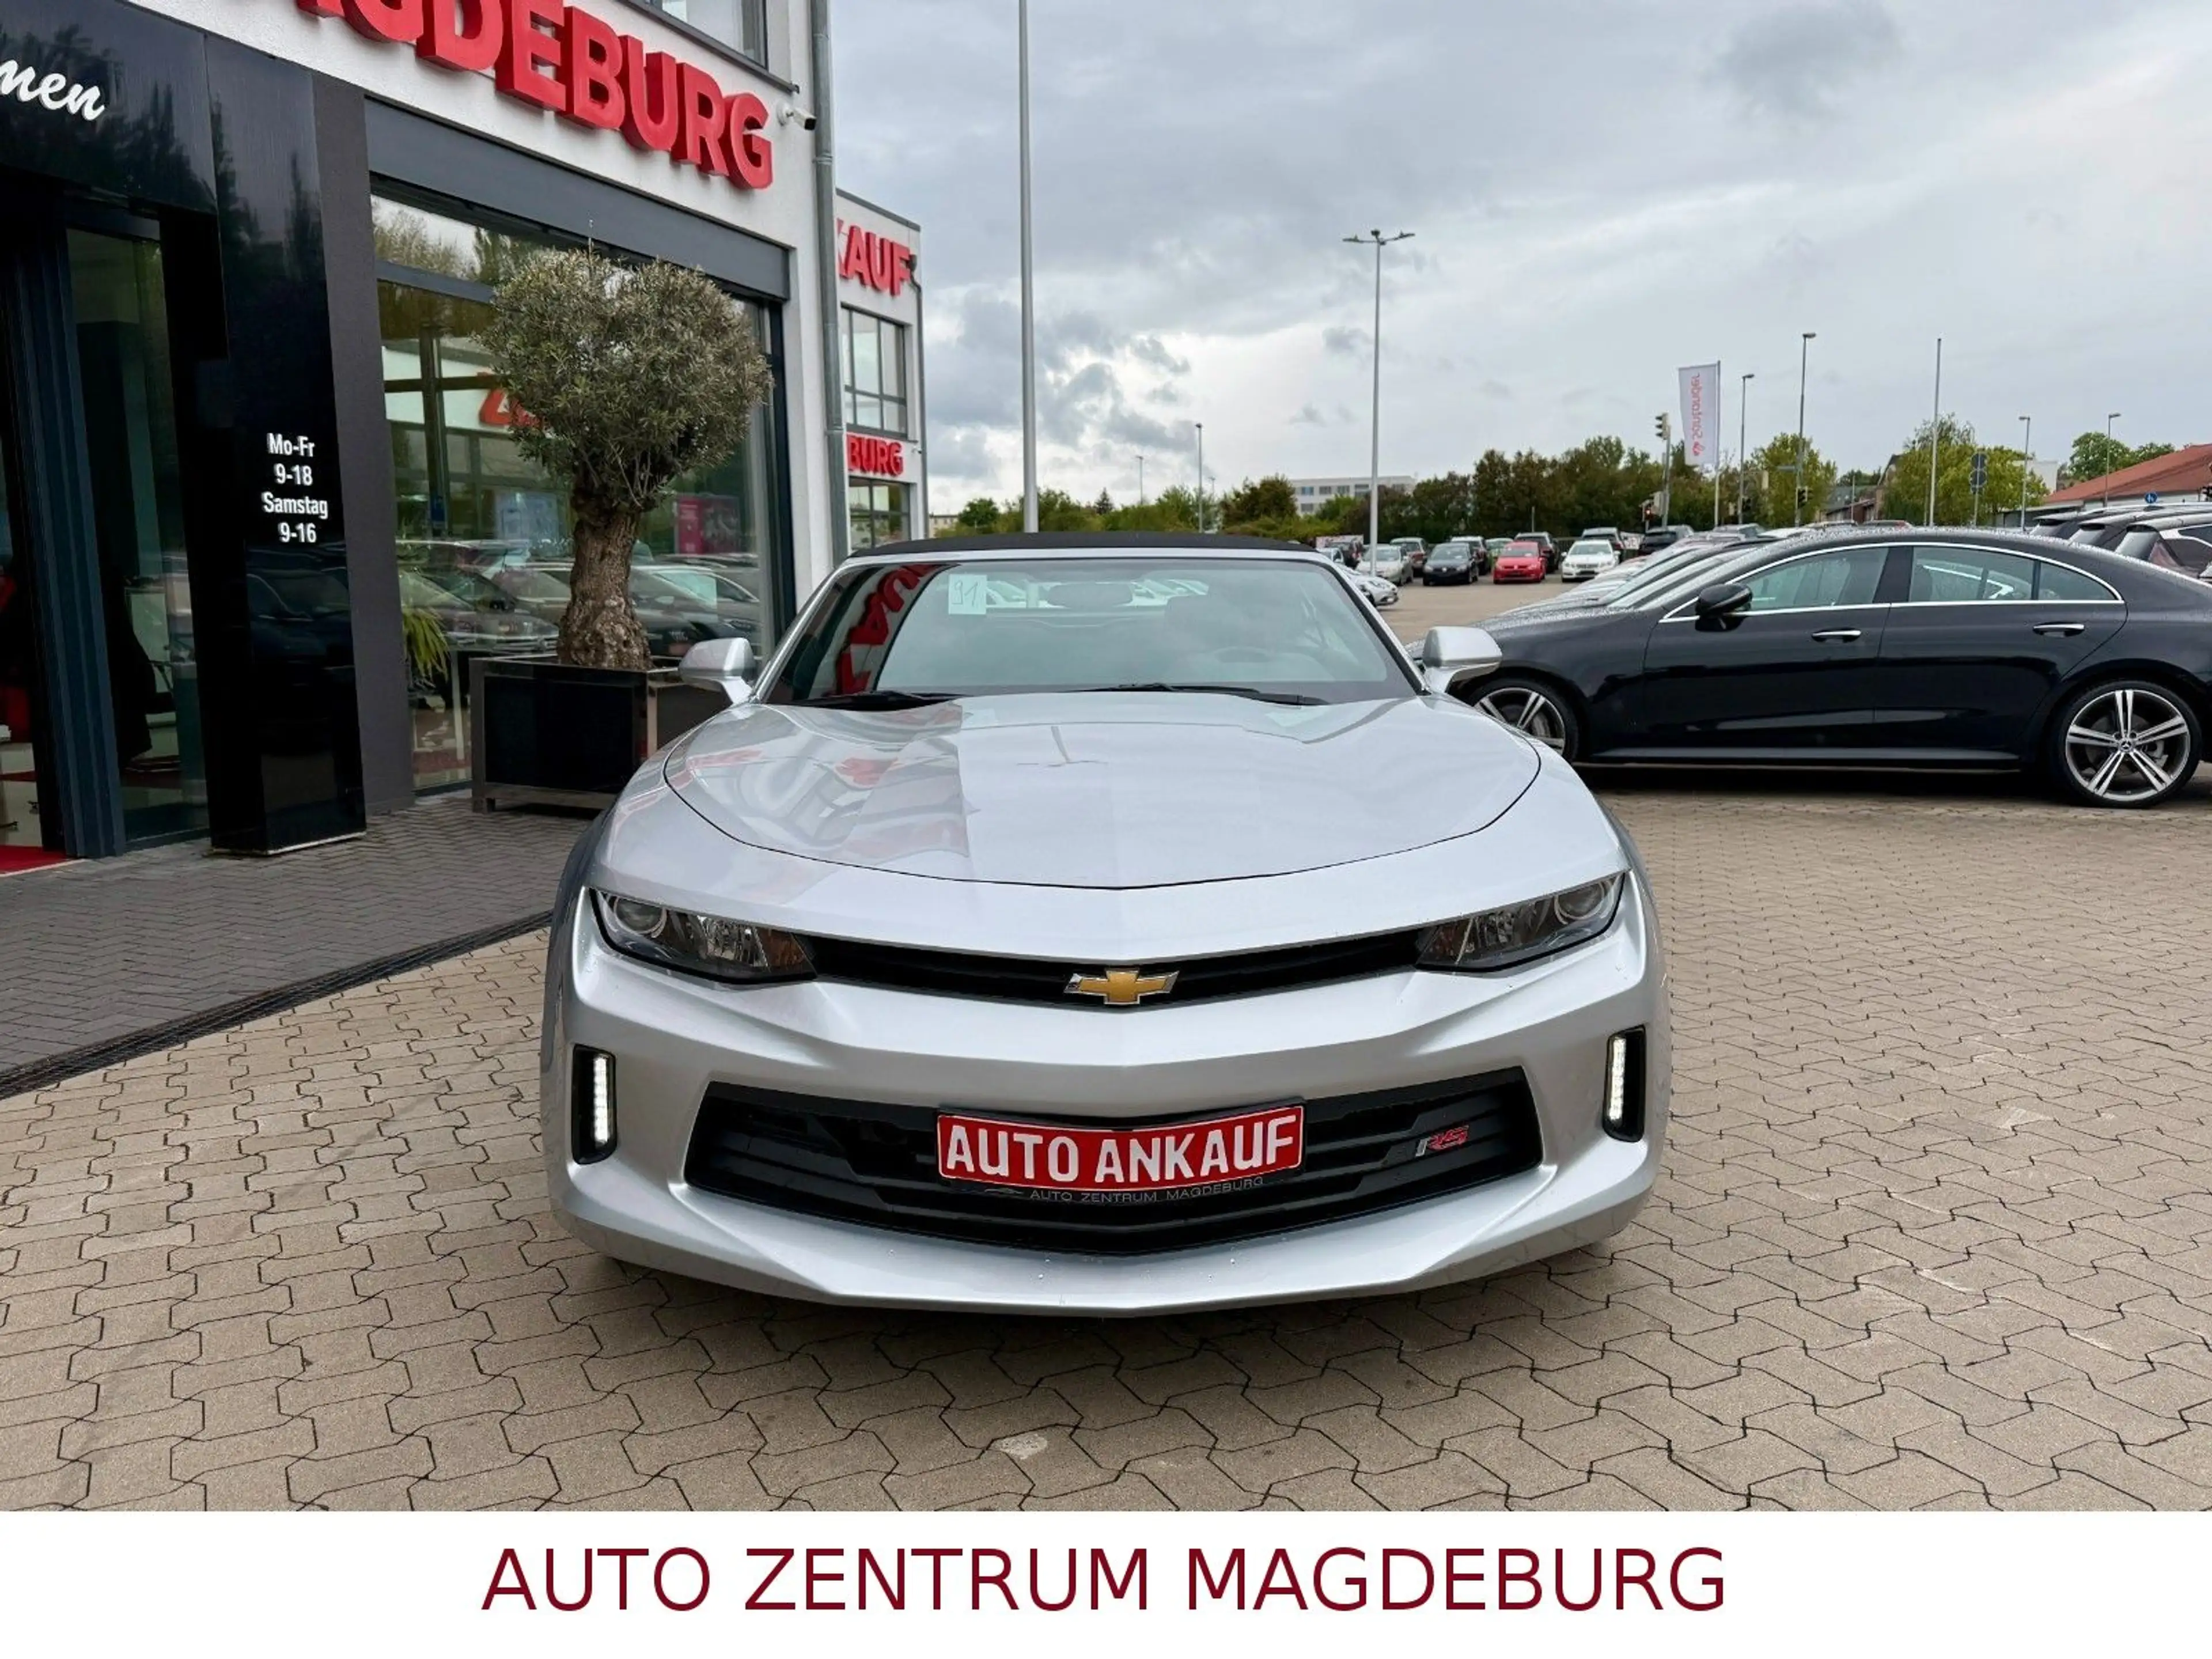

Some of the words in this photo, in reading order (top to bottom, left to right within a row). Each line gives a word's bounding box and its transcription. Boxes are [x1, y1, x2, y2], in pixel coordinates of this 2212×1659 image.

[267, 433, 315, 457] Mo-Fr
[274, 463, 313, 486] 9-18
[261, 491, 328, 520] Samstag
[278, 522, 316, 543] 9-16
[946, 1124, 1079, 1182] AUTO
[1094, 1115, 1296, 1183] ANKAUF
[1030, 1190, 1073, 1202] AUTO
[1081, 1192, 1157, 1203] ZENTRUM
[1166, 1176, 1263, 1200] MAGDEBURG
